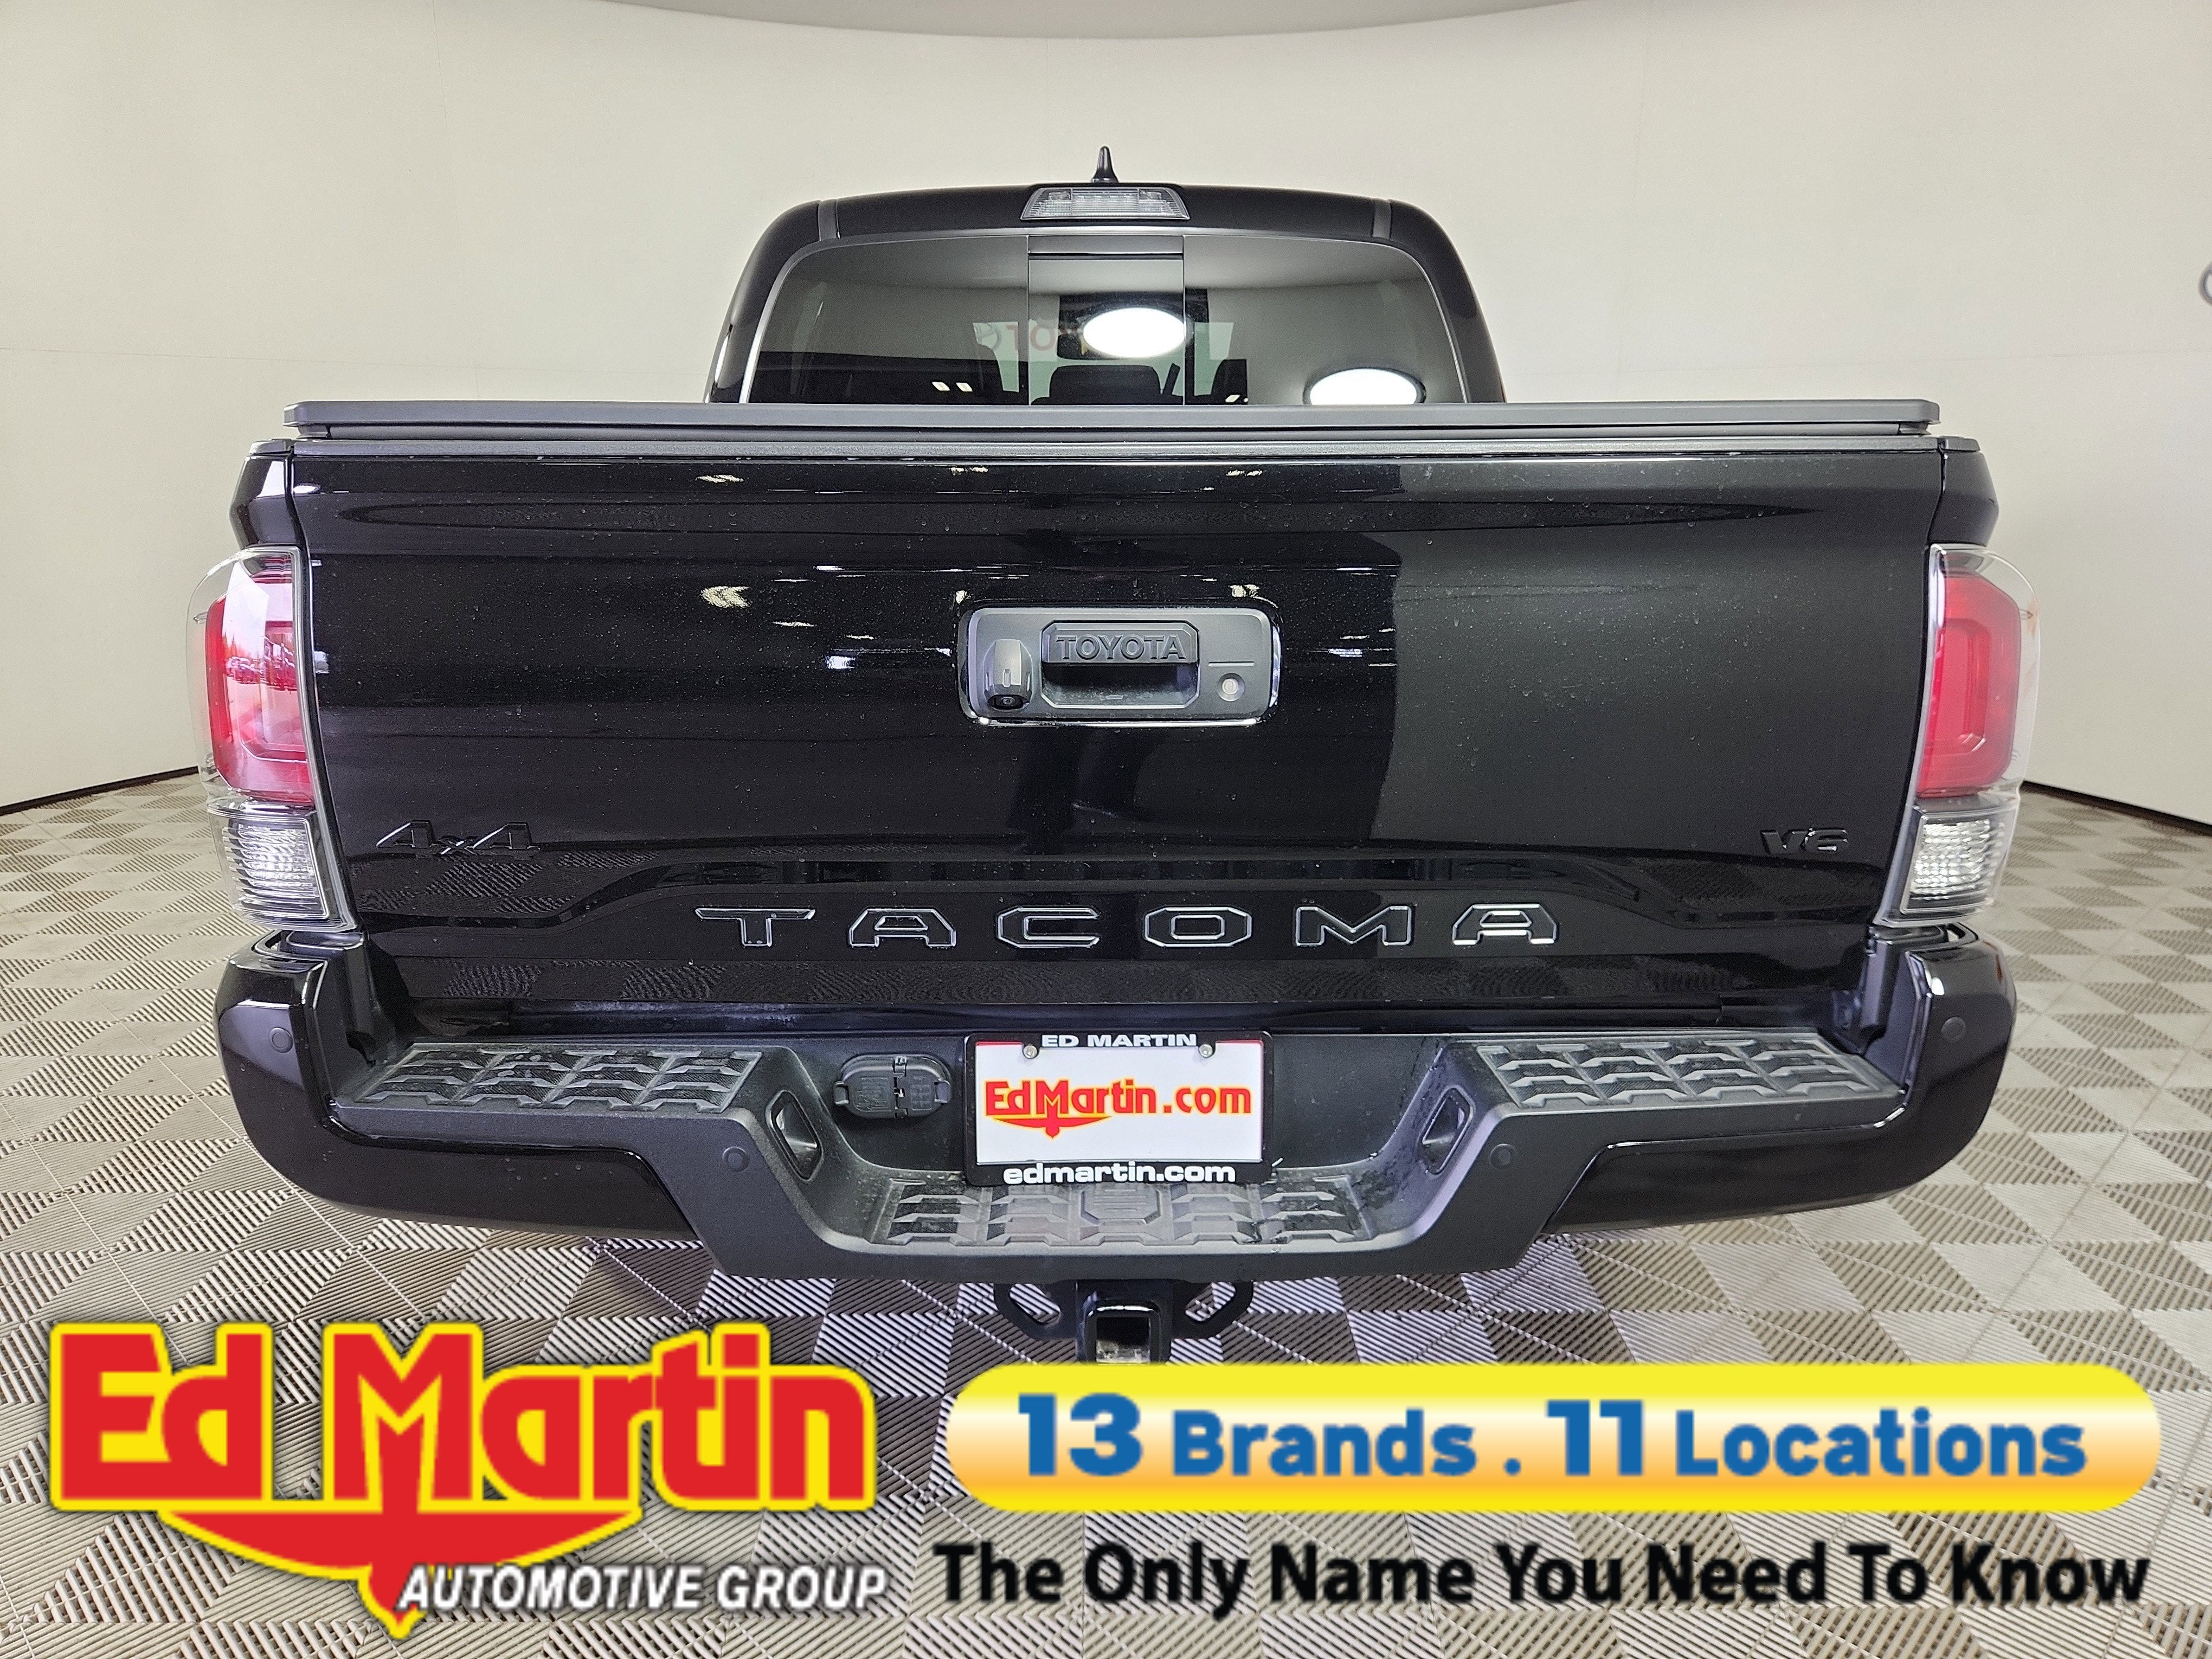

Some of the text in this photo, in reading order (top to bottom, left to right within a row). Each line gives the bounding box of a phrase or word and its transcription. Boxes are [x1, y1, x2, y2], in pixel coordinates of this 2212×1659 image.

[1055, 633, 1186, 660] TOYOTA
[1760, 827, 1848, 855] V6
[693, 902, 1561, 949] TACOMA
[1041, 1033, 1197, 1048] ED MARTIN
[985, 1079, 1252, 1116] EdMartin.com
[1002, 1162, 1236, 1185] edmartin.com
